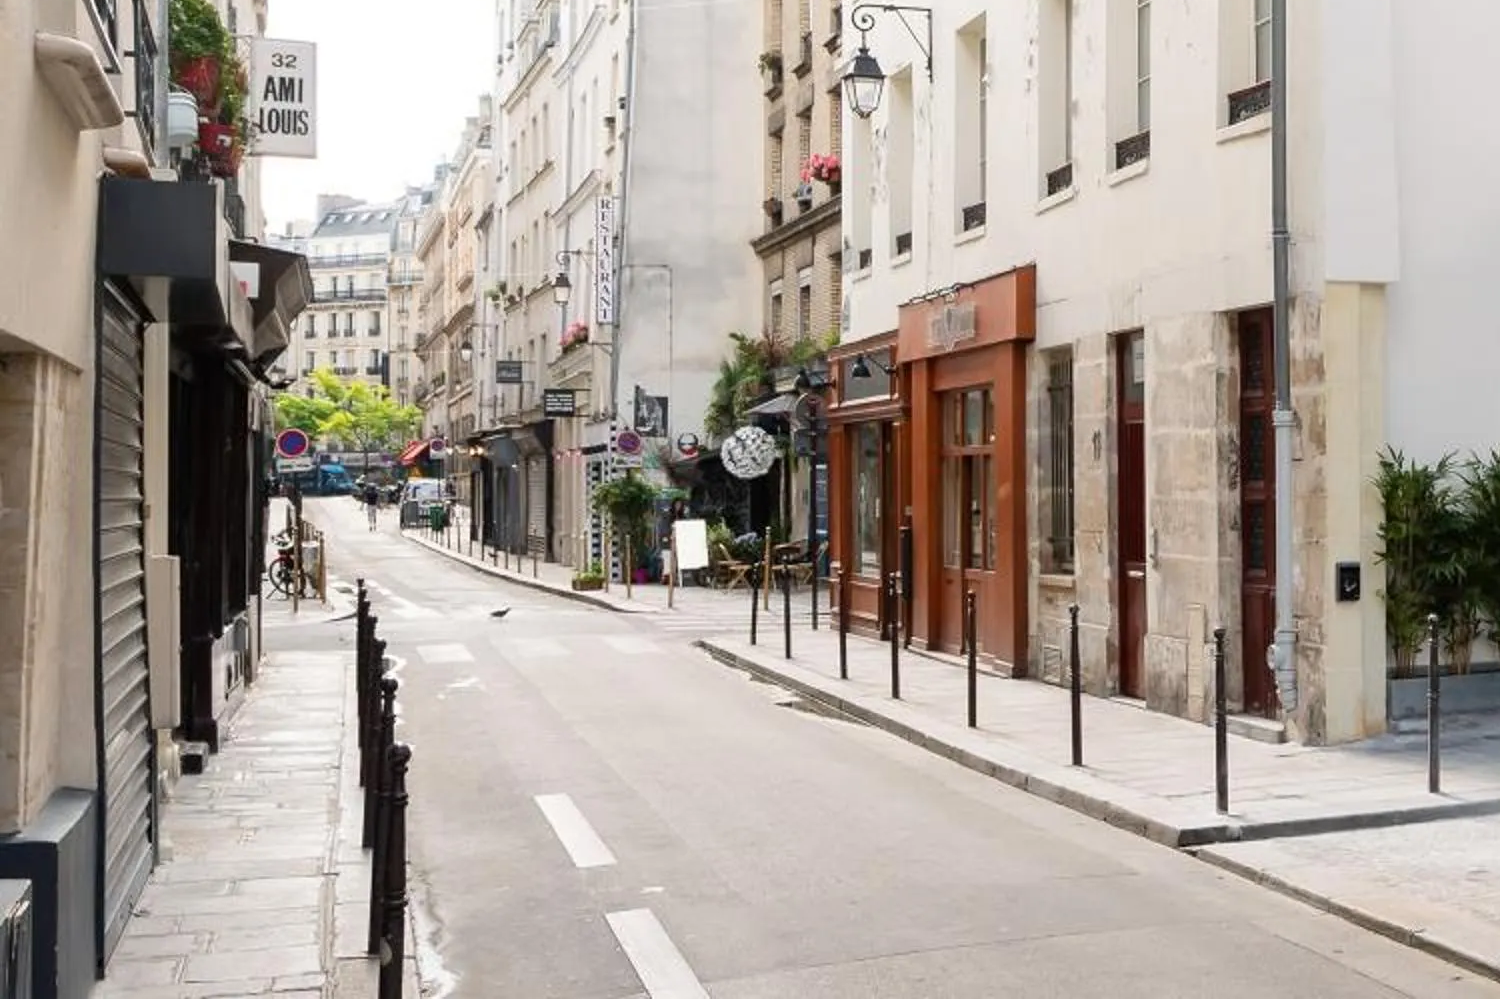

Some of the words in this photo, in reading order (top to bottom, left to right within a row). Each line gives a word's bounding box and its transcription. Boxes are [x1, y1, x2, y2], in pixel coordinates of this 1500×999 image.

[271, 52, 297, 69] 32
[263, 75, 304, 103] AMI
[259, 106, 309, 136] LOUIS
[600, 199, 611, 320] RESTAURANT
